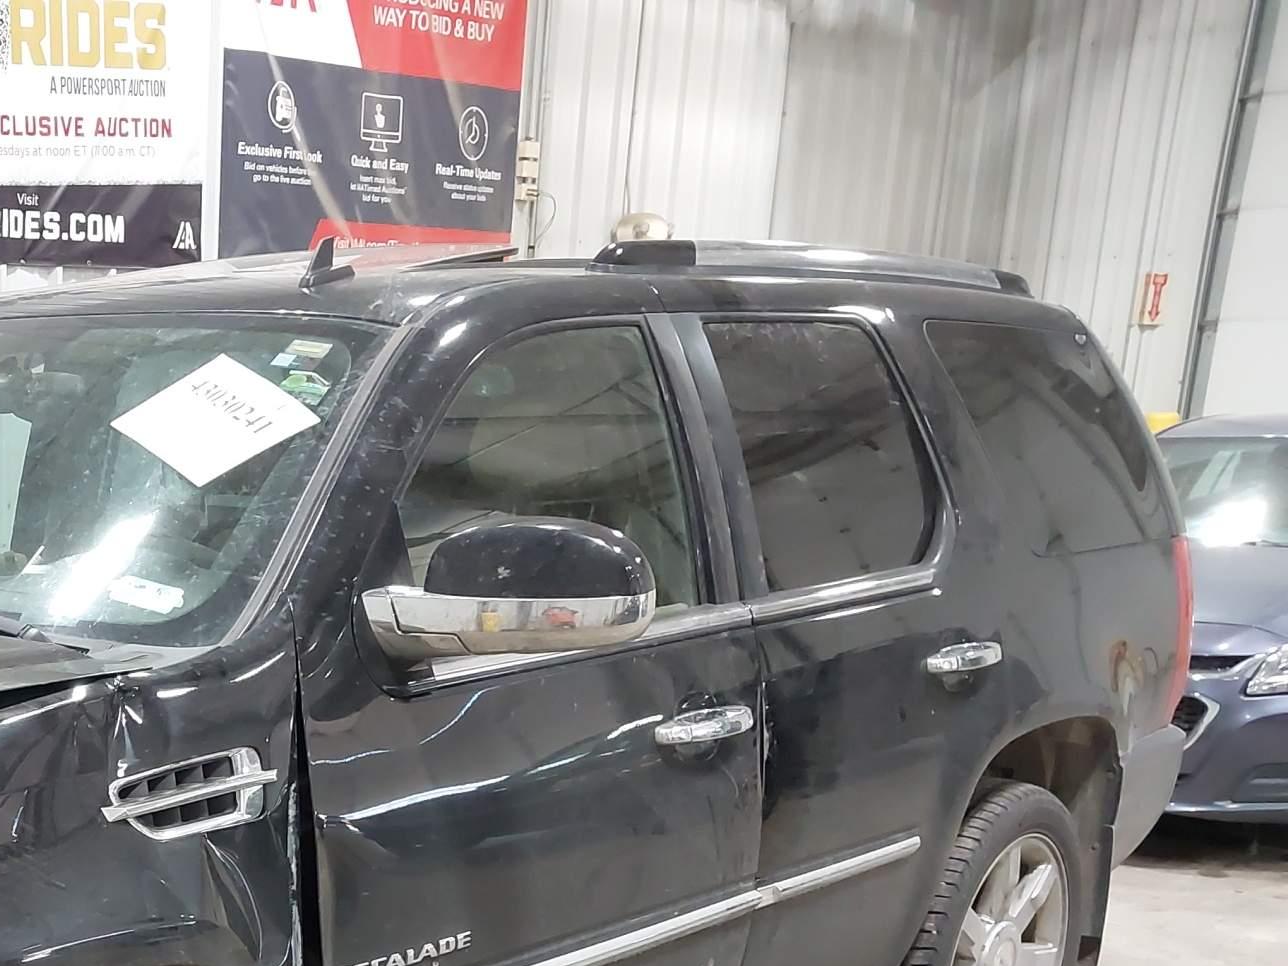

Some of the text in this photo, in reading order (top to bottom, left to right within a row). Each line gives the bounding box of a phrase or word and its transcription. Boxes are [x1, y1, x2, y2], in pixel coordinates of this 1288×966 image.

[462, 0, 471, 14] A
[474, 1, 505, 20] NEW
[373, 5, 495, 42] WAY TO BID & BUY
[50, 76, 166, 97] A POWERSPORT AUCTION
[94, 116, 173, 138] AUCTION
[32, 146, 42, 157] at
[46, 147, 71, 157] noon
[73, 145, 88, 157] ET
[237, 142, 282, 158] Exclusive
[283, 146, 304, 160] First
[350, 154, 409, 174] Quick and Easy
[435, 163, 502, 181] Real-Time Updates
[16, 193, 39, 206] Visit
